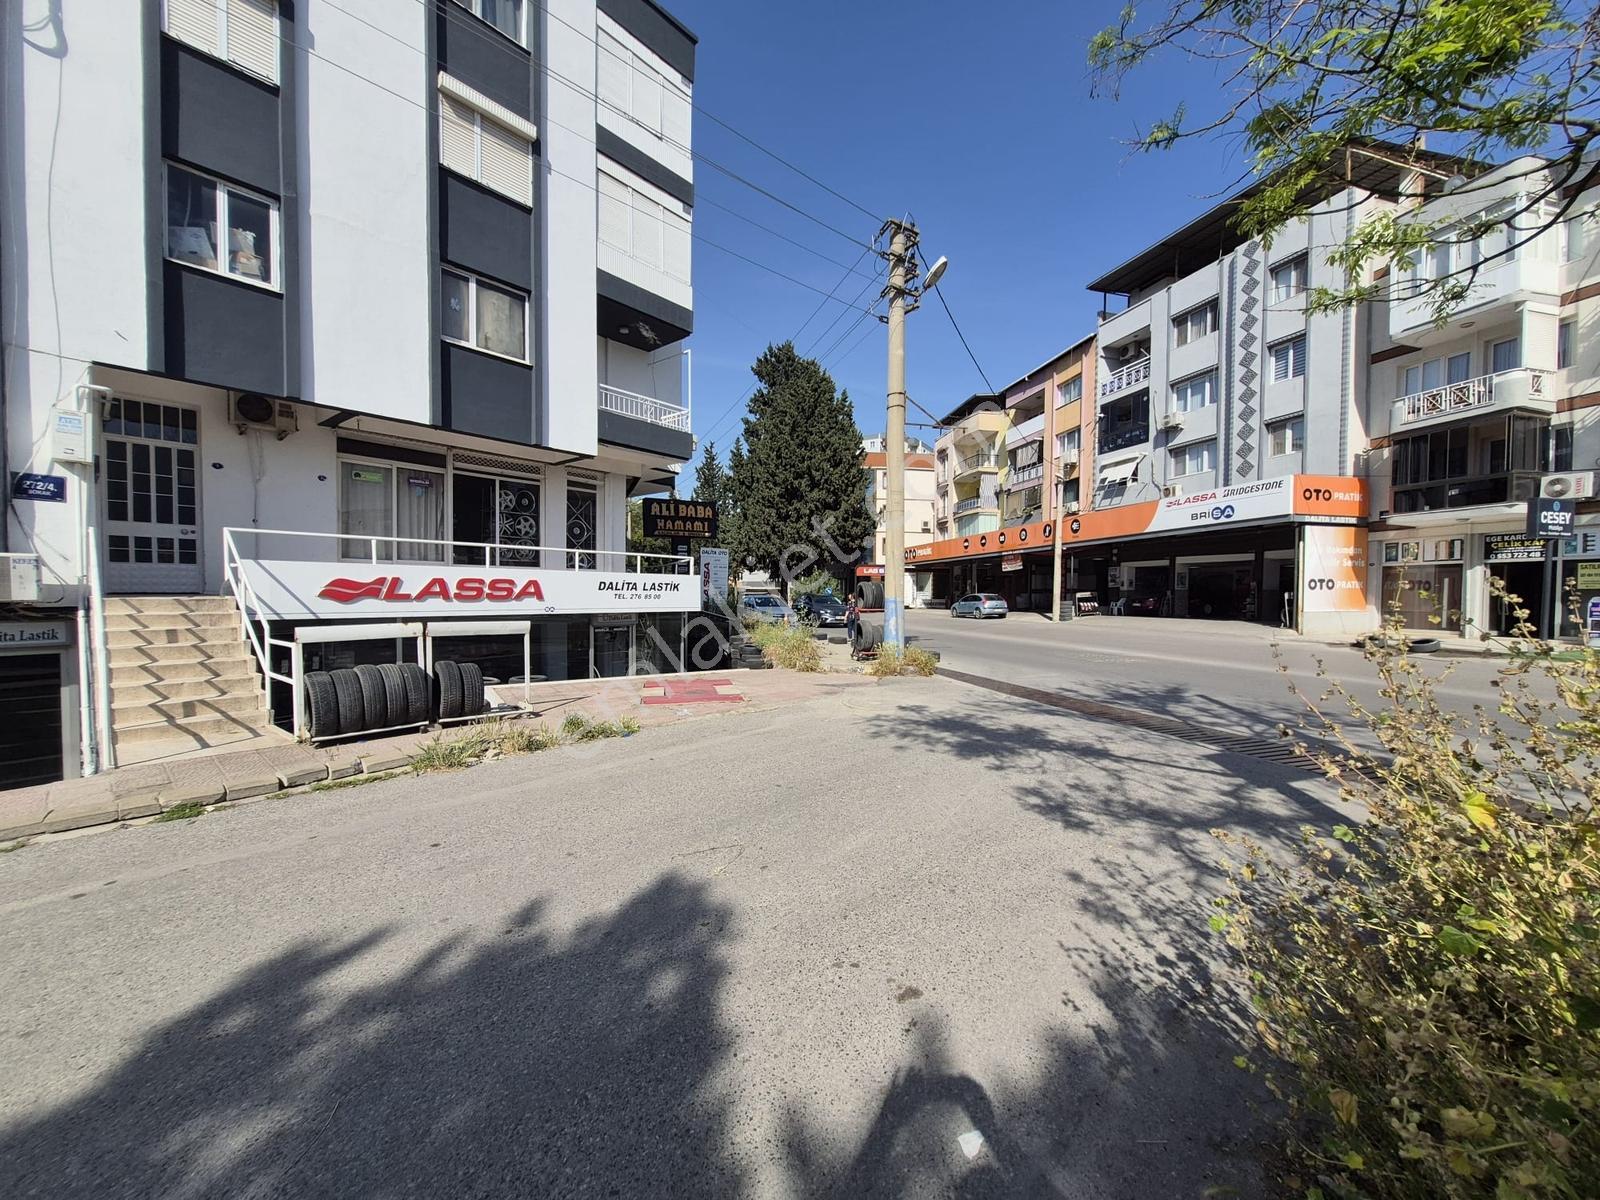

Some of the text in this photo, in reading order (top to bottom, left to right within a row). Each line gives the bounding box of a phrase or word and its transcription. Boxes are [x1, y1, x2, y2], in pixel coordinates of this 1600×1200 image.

[1177, 480, 1284, 506] LASSA BRIDGESTONE
[1303, 488, 1332, 501] OTO
[651, 501, 713, 519] ALİ BABA
[1541, 511, 1571, 524] CESEY
[656, 518, 709, 531] HAMAMI
[1491, 540, 1522, 549] ÇELİK
[381, 576, 544, 602] LASSA
[598, 580, 680, 592] DALİTA LASTİK
[1308, 579, 1335, 591] OTO
[19, 628, 59, 641] Lastik
